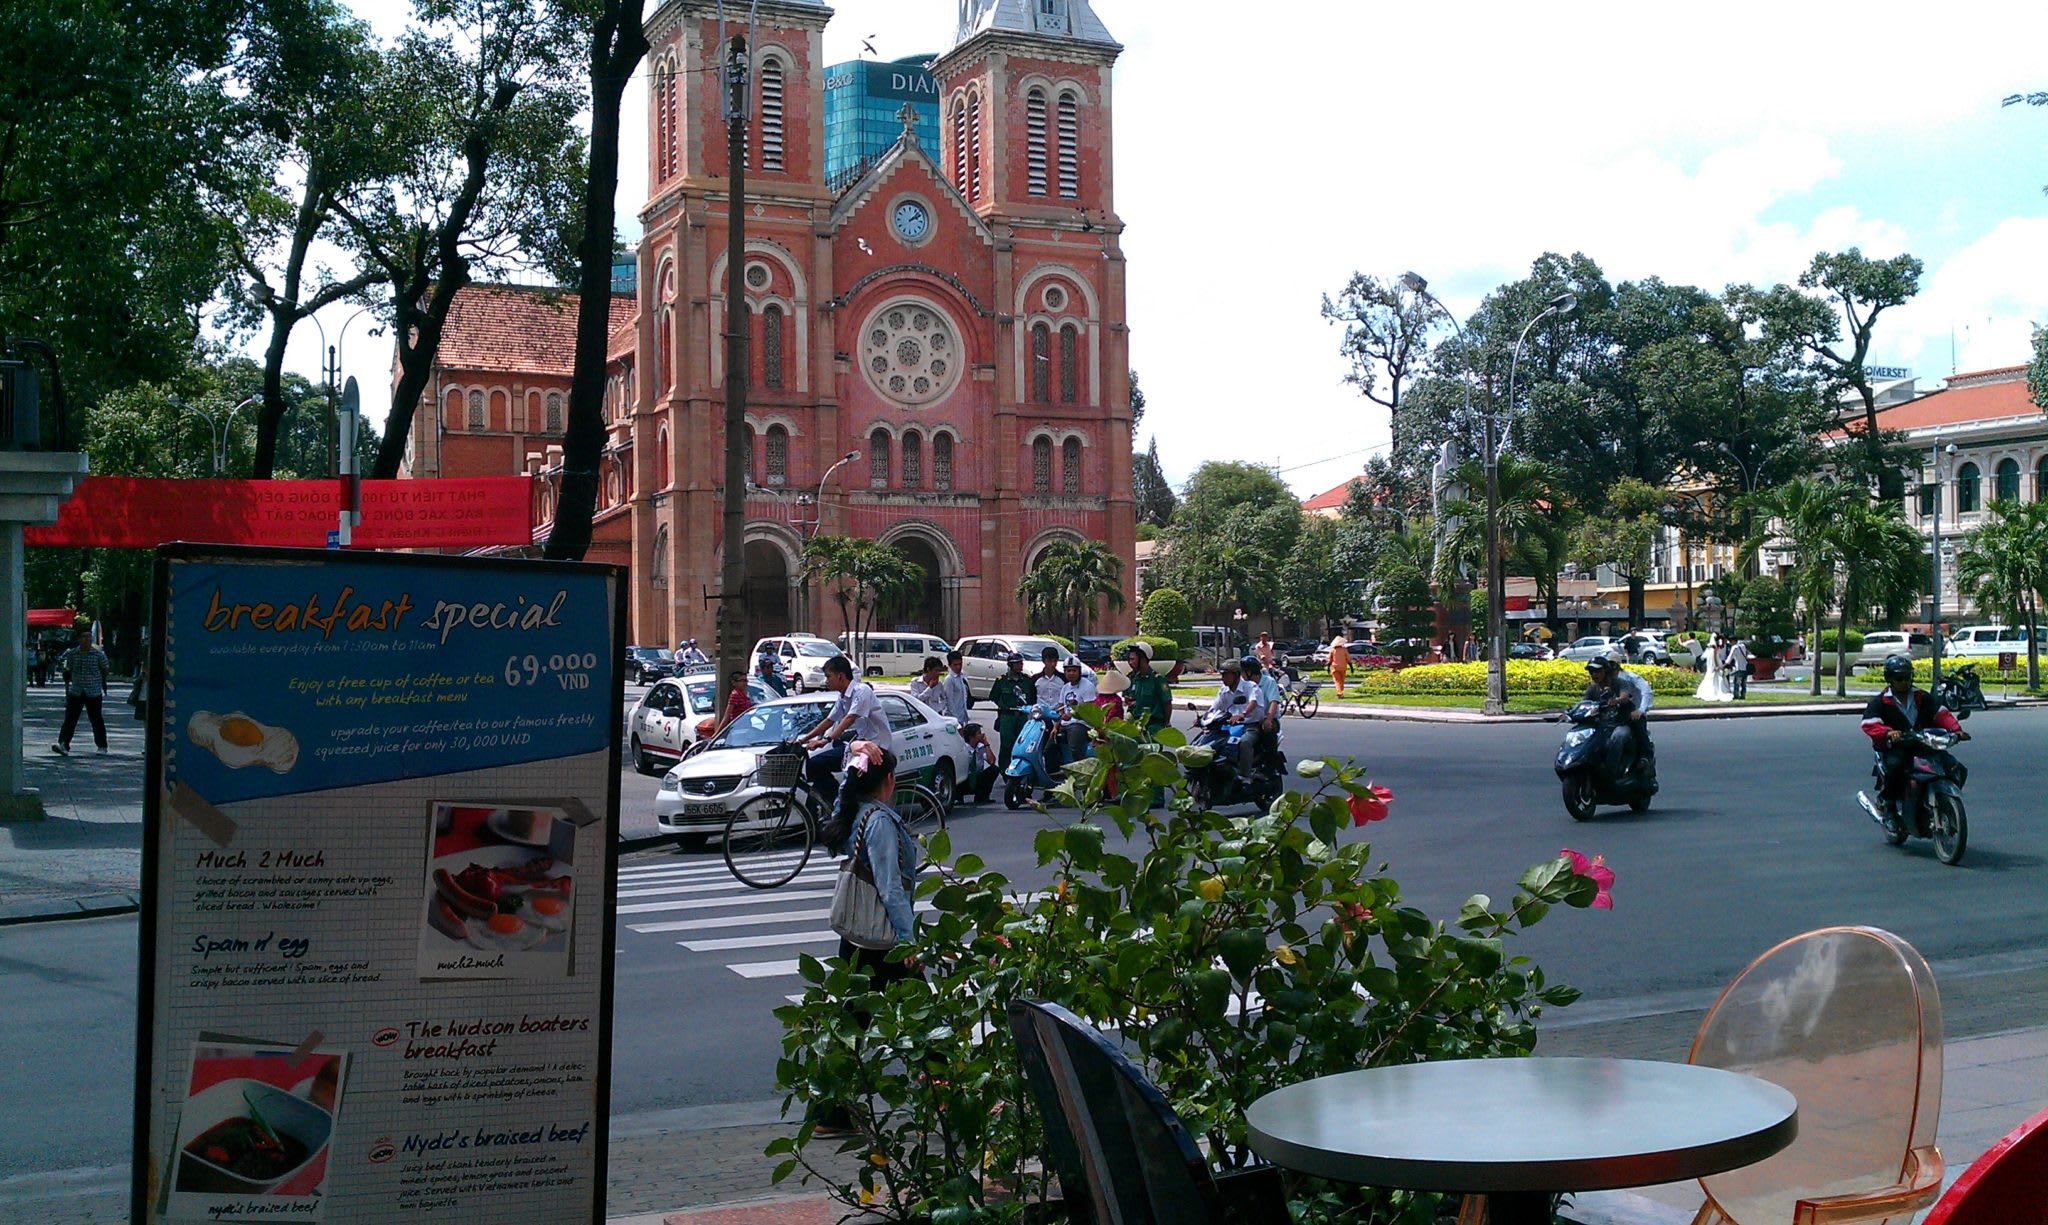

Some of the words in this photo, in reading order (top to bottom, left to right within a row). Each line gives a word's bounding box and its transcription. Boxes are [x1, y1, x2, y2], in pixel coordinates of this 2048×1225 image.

[1863, 366, 1908, 378] OMERSET
[203, 584, 415, 641] breakfast
[420, 589, 568, 646] special
[210, 643, 256, 655] available
[260, 643, 310, 656] everyday
[312, 641, 340, 654] from
[392, 639, 406, 651] to
[409, 640, 436, 650] 11am
[288, 677, 323, 694] Enjoy
[327, 680, 335, 689] a
[337, 676, 366, 691] free
[370, 678, 392, 690] cup
[396, 674, 409, 688] of
[412, 672, 452, 688] coffee
[456, 676, 471, 685] or
[474, 672, 495, 685] tea
[557, 673, 590, 690] VND
[316, 695, 341, 707] with
[346, 696, 366, 710] any
[372, 692, 433, 705] breakfast
[437, 692, 468, 702] menu
[331, 723, 379, 741] upgrade
[383, 724, 409, 738] your
[412, 719, 473, 734] coffee/tea
[475, 718, 489, 730] to
[491, 719, 511, 729] our
[513, 715, 554, 729] famous
[558, 713, 595, 728] freshly
[314, 743, 369, 762] squeezed
[369, 742, 401, 758] juice
[402, 740, 422, 754] for
[424, 739, 447, 753] only
[450, 735, 498, 751] 30,000
[501, 733, 531, 745] VND
[196, 850, 247, 869] Much
[259, 850, 271, 869] 2
[276, 850, 325, 868] Much
[196, 876, 226, 887] Choice
[229, 875, 241, 886] of
[242, 875, 292, 885] scrambled
[294, 877, 305, 885] or
[307, 877, 333, 886] sunny
[336, 874, 356, 884] side
[358, 878, 371, 886] up
[192, 888, 225, 902] grilled
[228, 889, 256, 899] bacon
[258, 888, 276, 898] and
[279, 890, 322, 901] sausages
[324, 888, 357, 897] served
[358, 887, 378, 896] with
[196, 902, 223, 912] sliced
[192, 934, 249, 960] Spam
[278, 938, 310, 959] egg
[192, 965, 223, 977] Simple
[226, 966, 241, 975] but
[329, 962, 349, 974] eggs
[351, 961, 369, 971] and
[190, 978, 219, 991] crispy
[222, 977, 250, 987] bacon
[252, 976, 286, 986] served
[288, 976, 308, 985] with
[318, 974, 338, 984] slice
[340, 974, 351, 985] of
[406, 1021, 442, 1039] The
[447, 1018, 515, 1037] hudson
[518, 1014, 590, 1034] boaters
[404, 1038, 498, 1061] breakfast
[402, 1080, 425, 1091] table
[428, 1080, 449, 1091] hash
[450, 1078, 461, 1090] of
[462, 1078, 488, 1088] diced
[566, 1073, 584, 1083] ham
[404, 1068, 439, 1081] Brought
[440, 1068, 461, 1079] back
[462, 1067, 473, 1079] by
[474, 1065, 507, 1079] popular
[402, 1095, 420, 1105] and
[424, 1096, 443, 1106] eggs
[444, 1093, 463, 1103] with
[514, 1088, 526, 1100] of
[474, 1126, 544, 1149] braised
[548, 1121, 590, 1145] beef
[401, 1164, 422, 1176] Juicy
[425, 1160, 446, 1172] beef
[446, 1159, 473, 1171] shank
[475, 1156, 512, 1170] tenderly
[514, 1155, 547, 1166] braised
[548, 1156, 557, 1164] in
[514, 1168, 532, 1177] and
[535, 1166, 569, 1176] coconut
[424, 1186, 457, 1196] Served
[459, 1184, 478, 1194] with
[479, 1182, 529, 1193] Vietnamese
[531, 1178, 555, 1189] herbs
[556, 1176, 575, 1186] and
[246, 1201, 288, 1214] braised
[291, 1200, 319, 1215] beef
[418, 1198, 458, 1211] baguette
